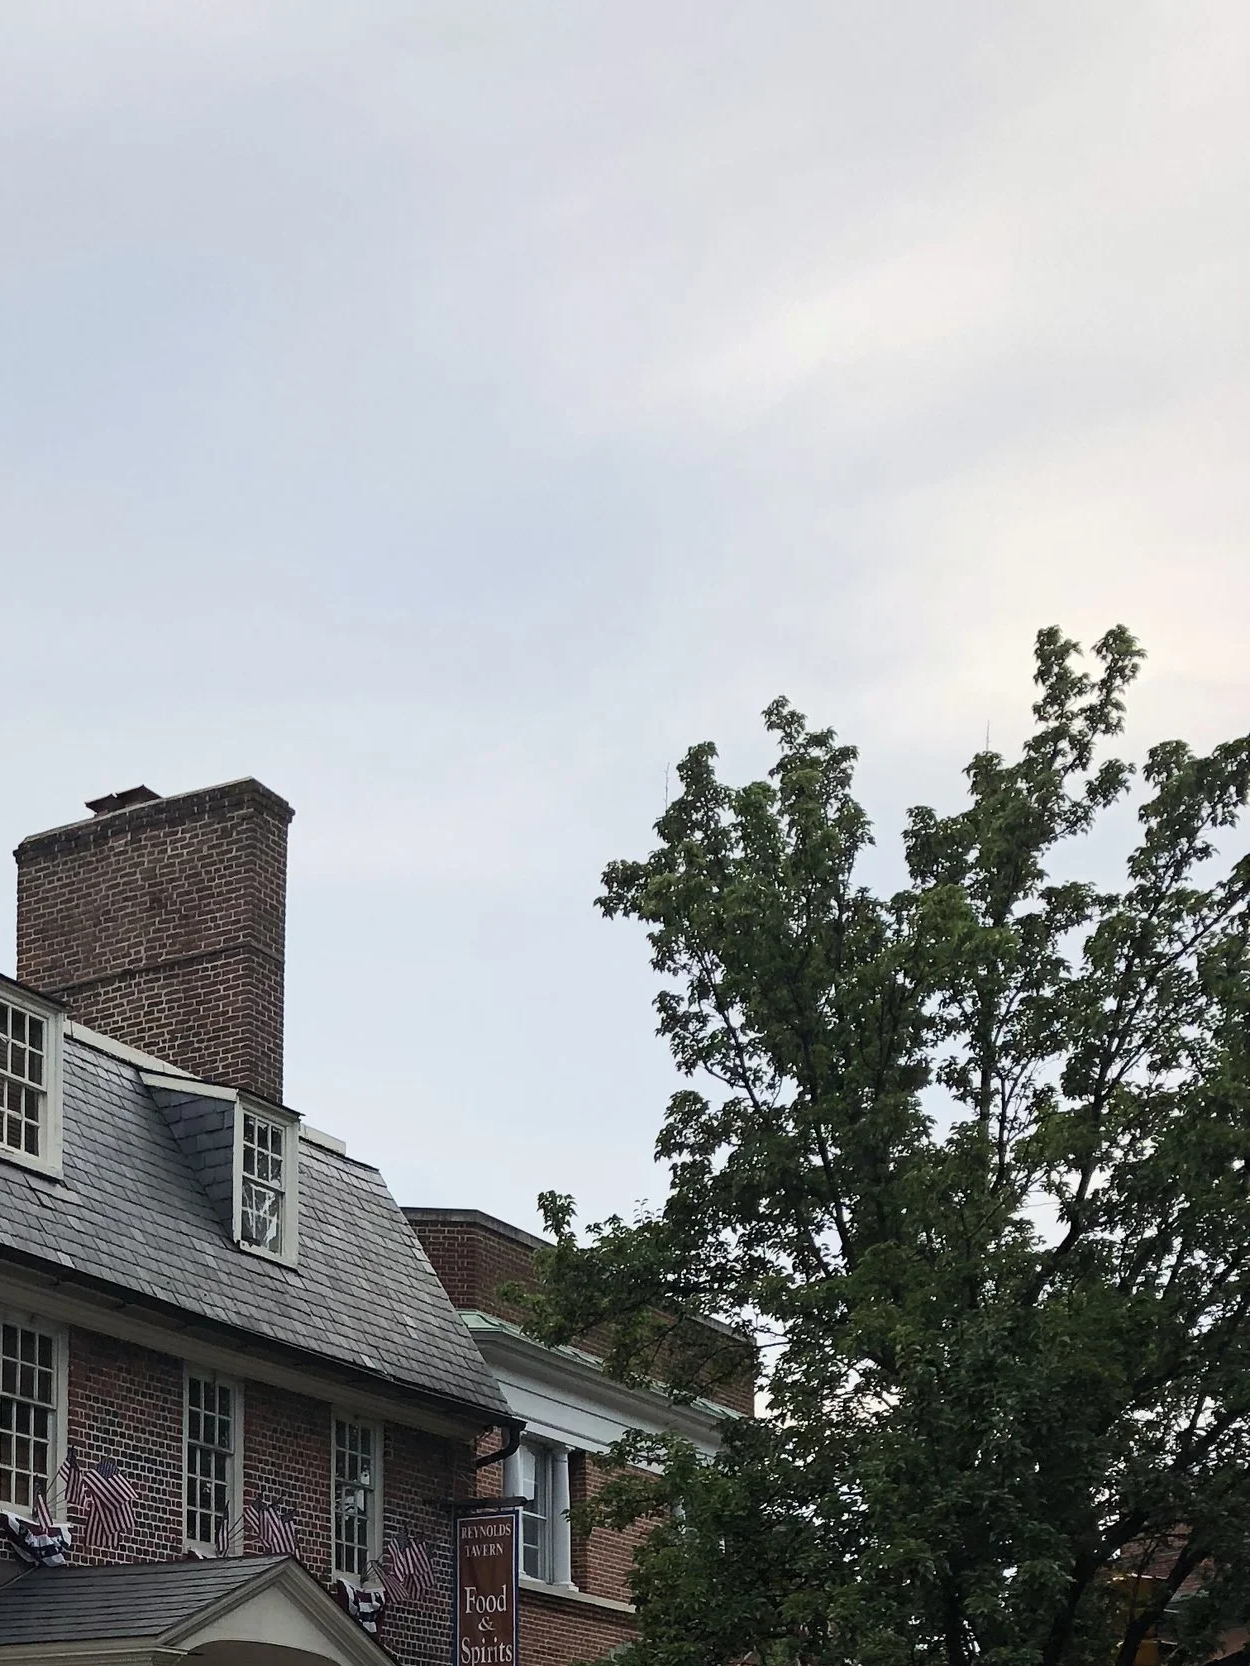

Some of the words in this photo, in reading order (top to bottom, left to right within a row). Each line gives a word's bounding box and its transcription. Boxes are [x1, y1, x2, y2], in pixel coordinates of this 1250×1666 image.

[461, 1523, 511, 1539] REYNOLDS
[464, 1543, 503, 1558] TAVERN
[464, 1585, 507, 1614] Food
[478, 1616, 495, 1631] &
